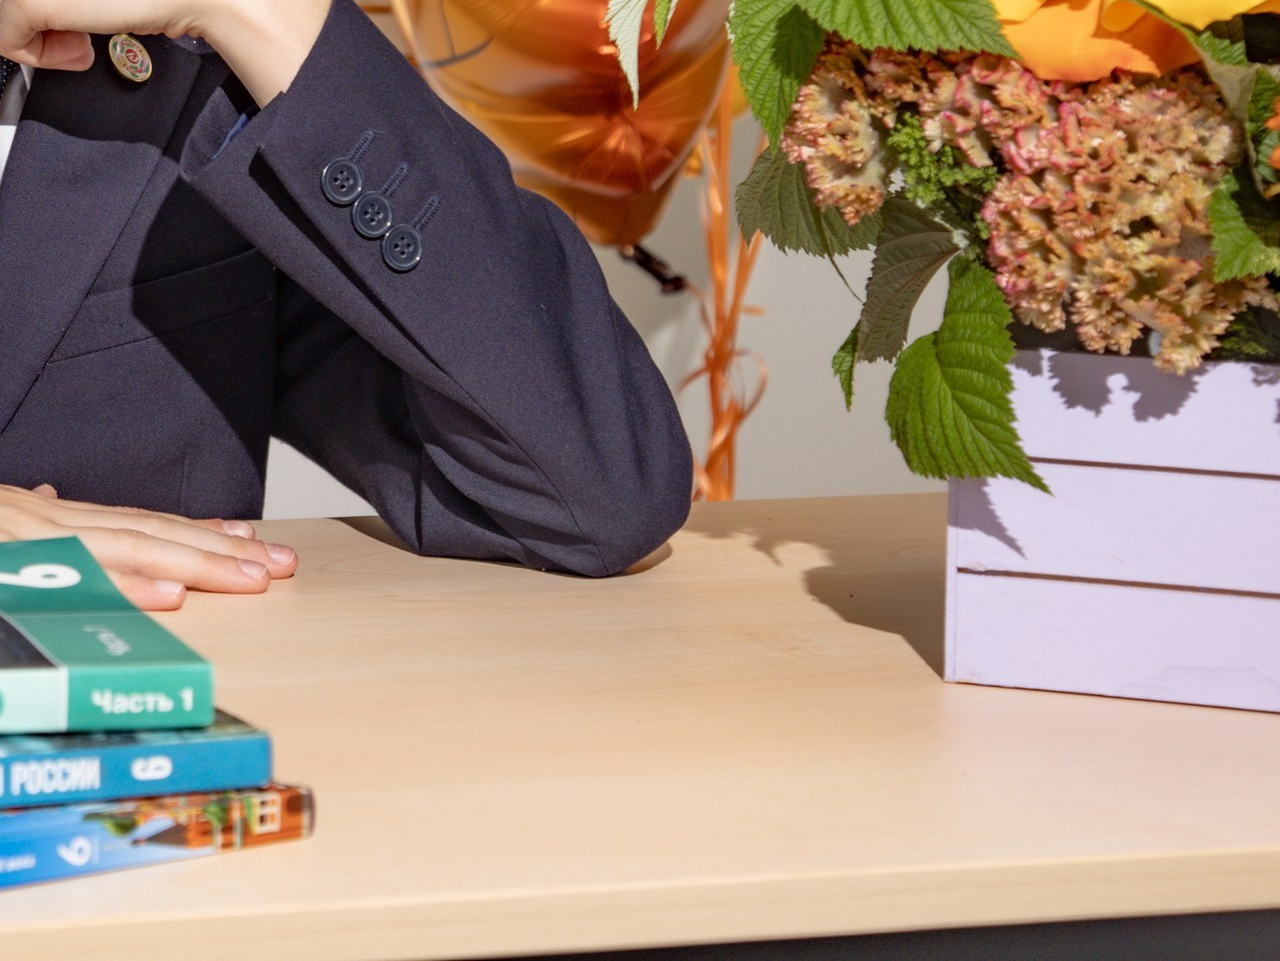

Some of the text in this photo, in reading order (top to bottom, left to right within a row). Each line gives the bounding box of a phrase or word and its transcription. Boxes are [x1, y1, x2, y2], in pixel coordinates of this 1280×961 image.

[90, 686, 195, 714] Часть 1
[10, 755, 102, 796] РОССИИ
[130, 754, 173, 781] 6
[57, 835, 93, 868] 6
